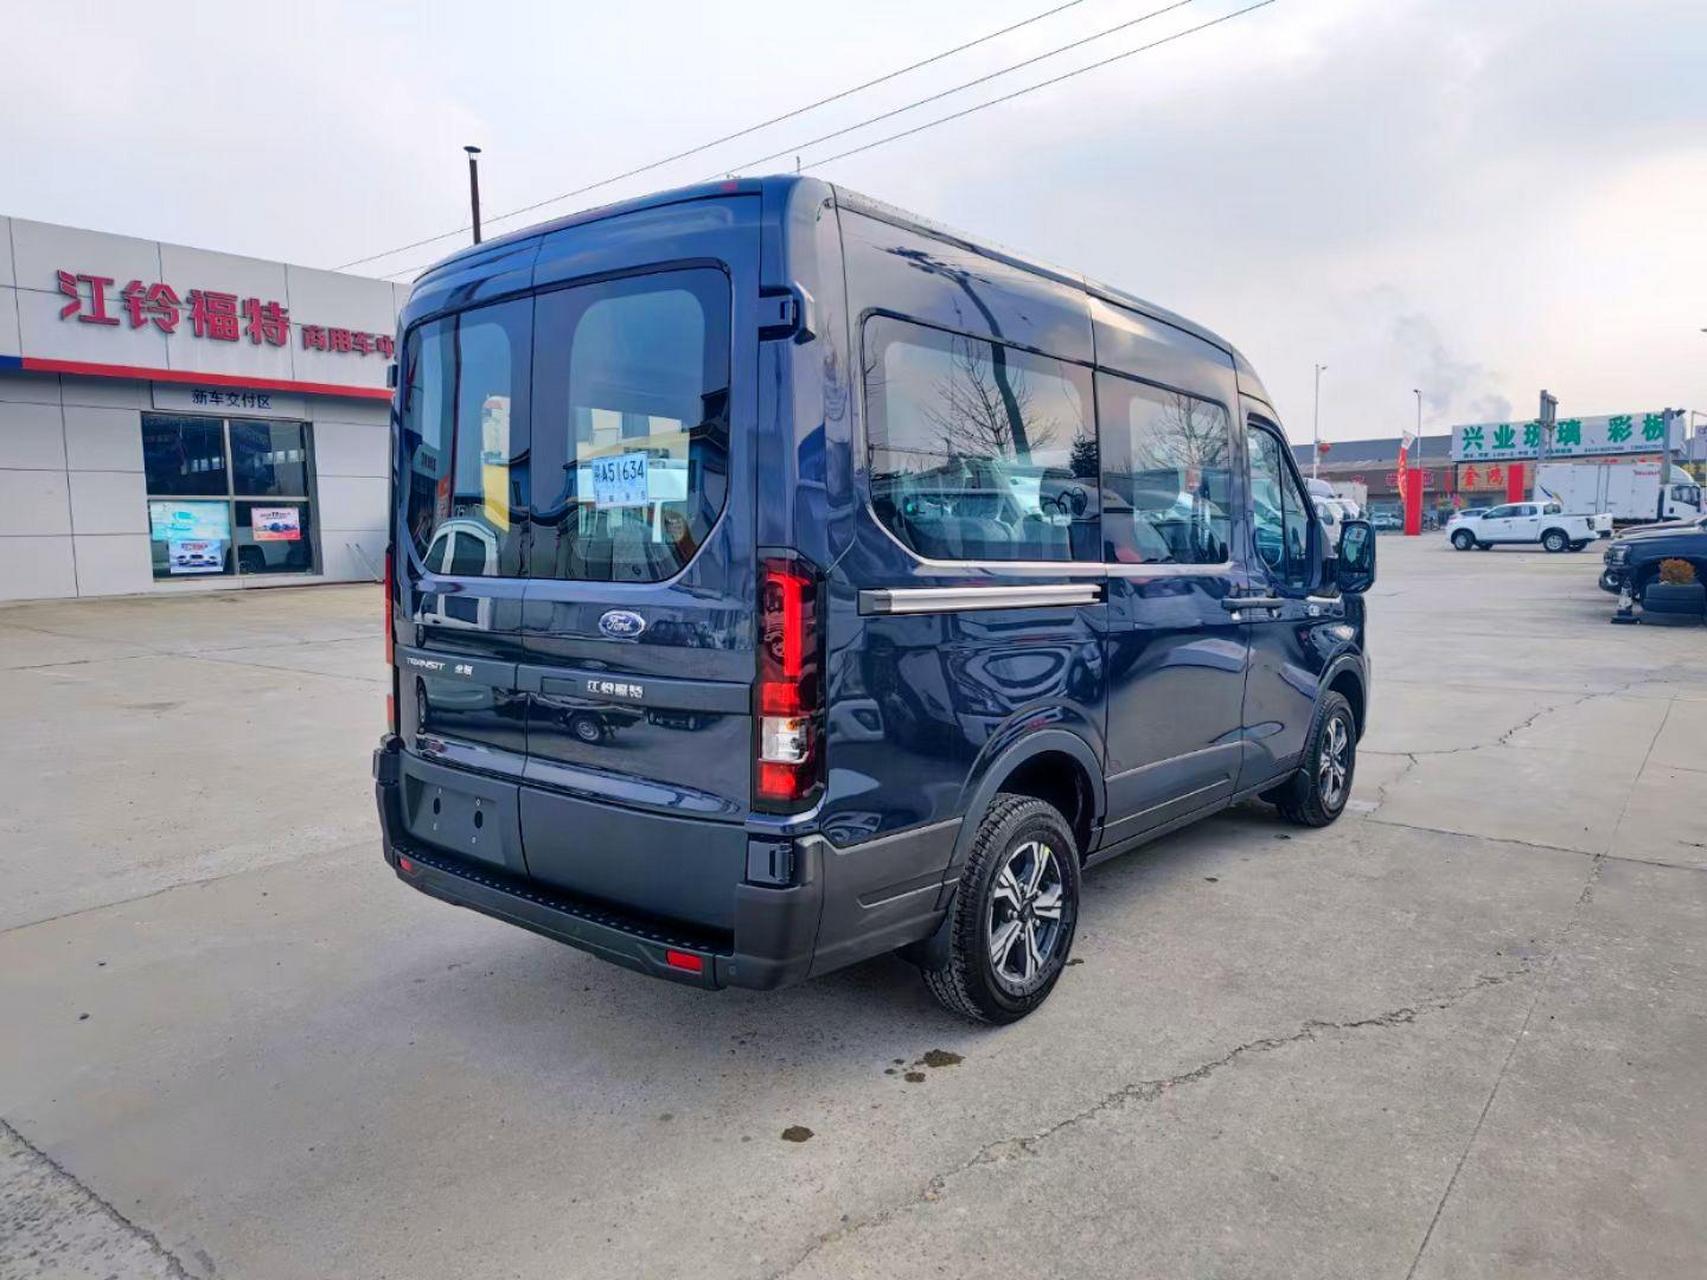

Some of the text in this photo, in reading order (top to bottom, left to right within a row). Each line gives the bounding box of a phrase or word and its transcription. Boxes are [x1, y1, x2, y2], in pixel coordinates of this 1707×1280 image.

[58, 269, 291, 347] 江铃福特
[190, 389, 272, 409] 新车交付区
[587, 680, 643, 698] 江铃福特
